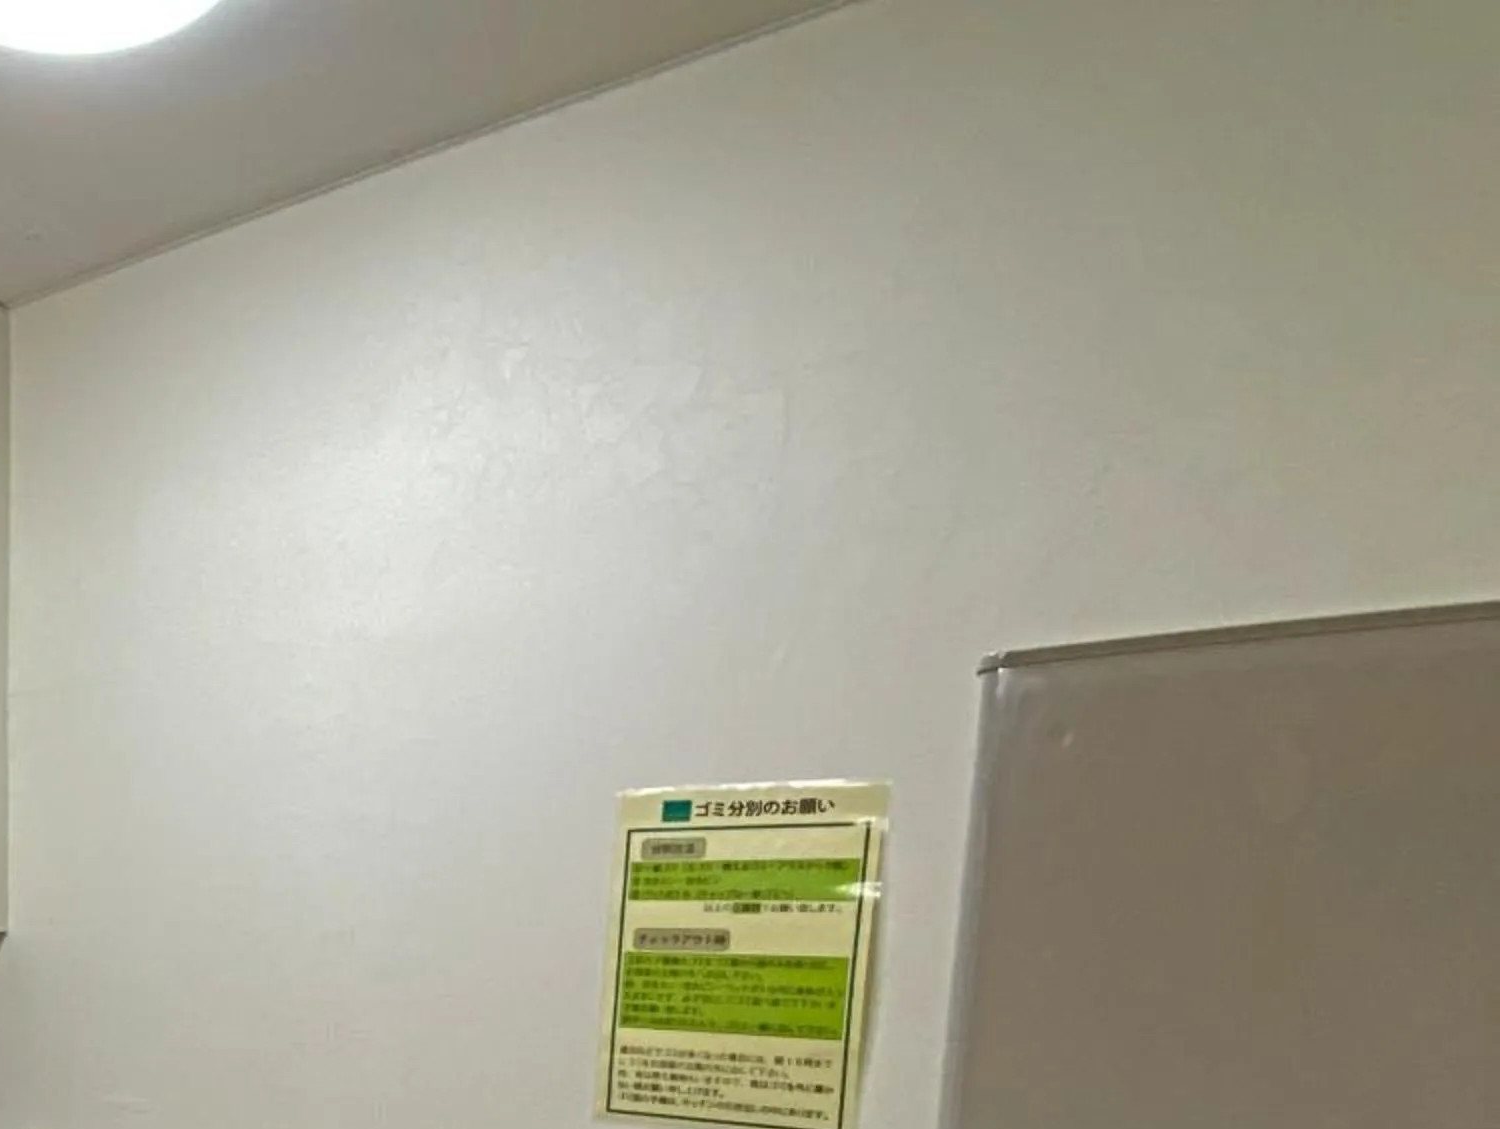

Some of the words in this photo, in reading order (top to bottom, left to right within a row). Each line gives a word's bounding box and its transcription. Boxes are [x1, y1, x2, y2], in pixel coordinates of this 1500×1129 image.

[694, 797, 836, 817] ゴミ分別のお願い
